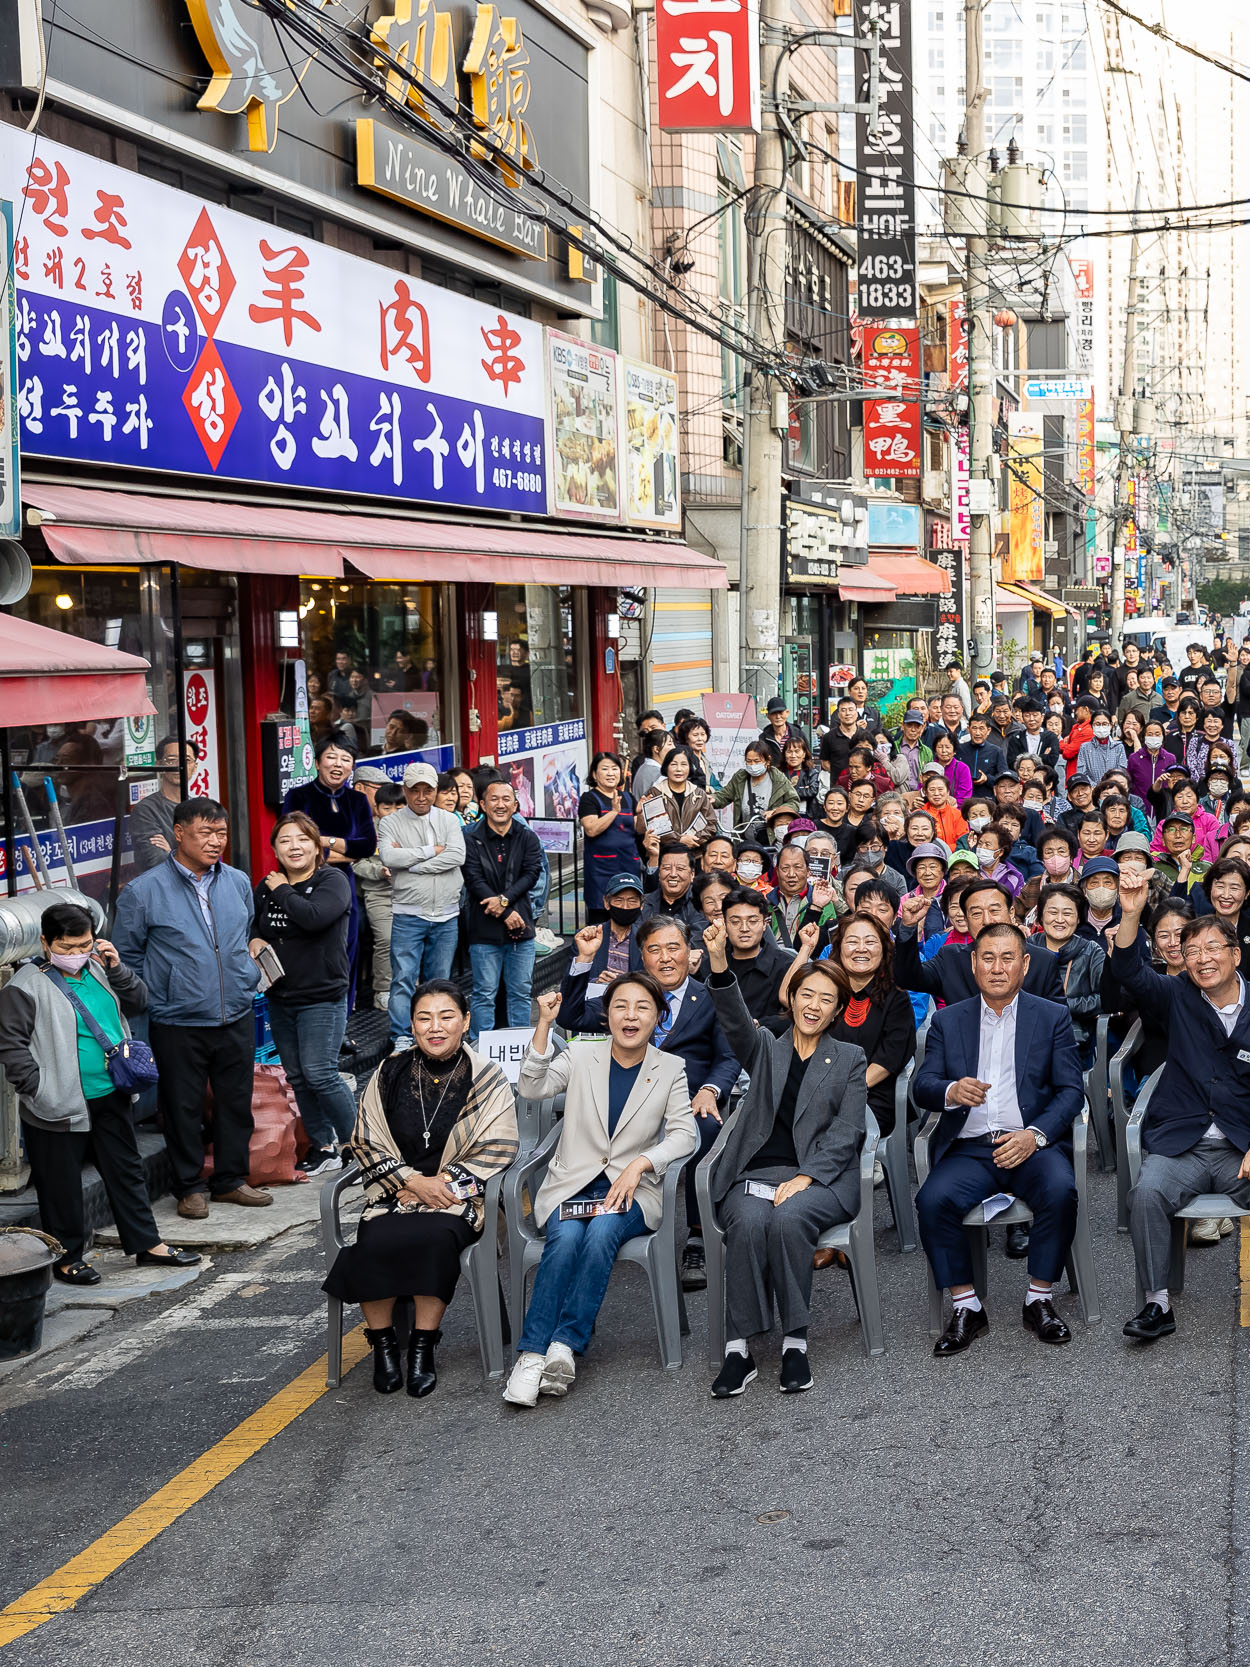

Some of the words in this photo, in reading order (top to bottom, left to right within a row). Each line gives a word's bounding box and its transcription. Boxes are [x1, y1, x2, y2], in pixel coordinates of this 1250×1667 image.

[665, 0, 741, 117] 치
[22, 157, 131, 250] 원조
[386, 140, 439, 202] Nine
[446, 168, 506, 235] Whale
[513, 213, 541, 248] Bar
[863, 214, 909, 240] HOF
[859, 283, 913, 307] 1833
[860, 255, 914, 279] 463-
[15, 297, 147, 386] 양꼬치거리
[166, 306, 190, 354] 구
[249, 239, 526, 399] 羊肉串
[18, 375, 153, 450] 선두주자
[258, 362, 485, 494] 양꼬치구이
[493, 467, 542, 493] 467-6880
[187, 686, 208, 712] 원조
[489, 1045, 525, 1063] 내빈
